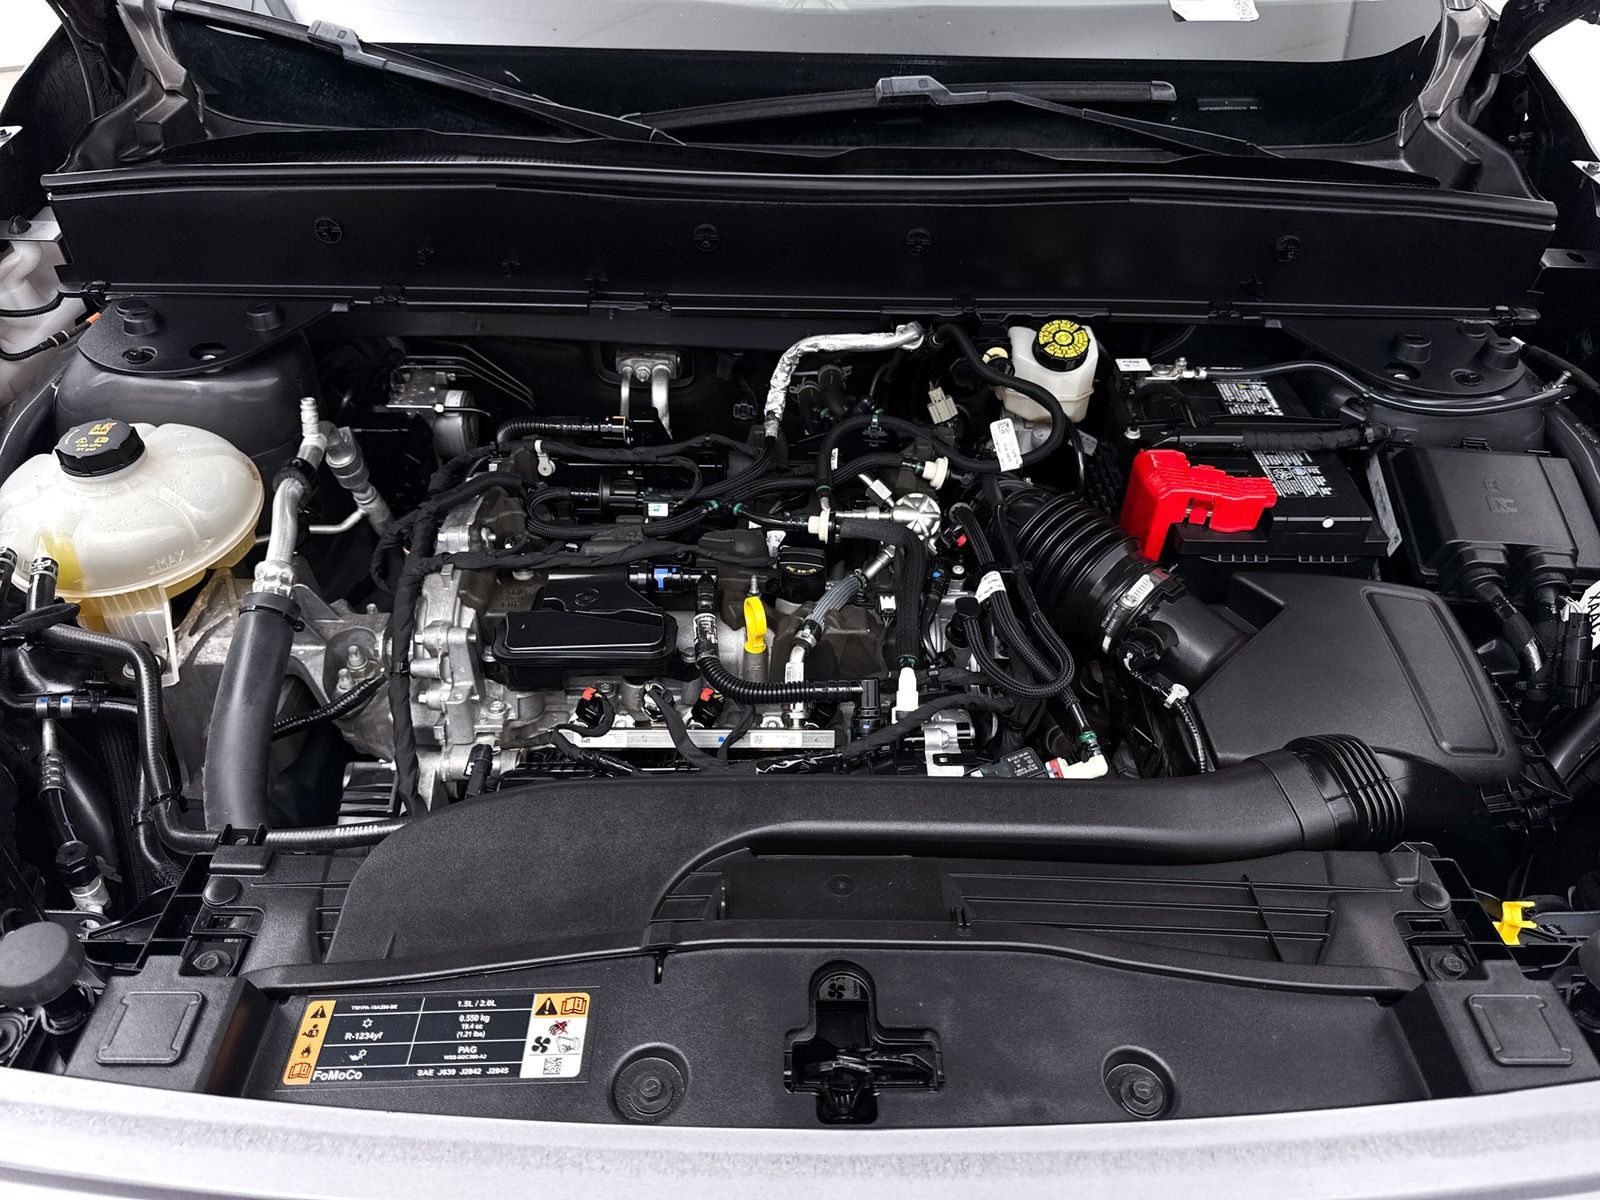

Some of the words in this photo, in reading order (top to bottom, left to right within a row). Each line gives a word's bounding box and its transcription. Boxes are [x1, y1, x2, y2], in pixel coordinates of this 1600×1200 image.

[154, 549, 185, 571] MAX
[457, 1000, 474, 1008] 1.5L
[479, 999, 497, 1007] 2.0L
[458, 1014, 479, 1022] 0.550
[480, 1013, 491, 1023] kg
[344, 1031, 384, 1041] R-1234yf
[457, 1045, 478, 1054] PAG
[312, 1069, 363, 1081] FoMoCo
[437, 1068, 456, 1076] J639
[459, 1068, 482, 1076] J2842
[486, 1067, 510, 1075] J2845
